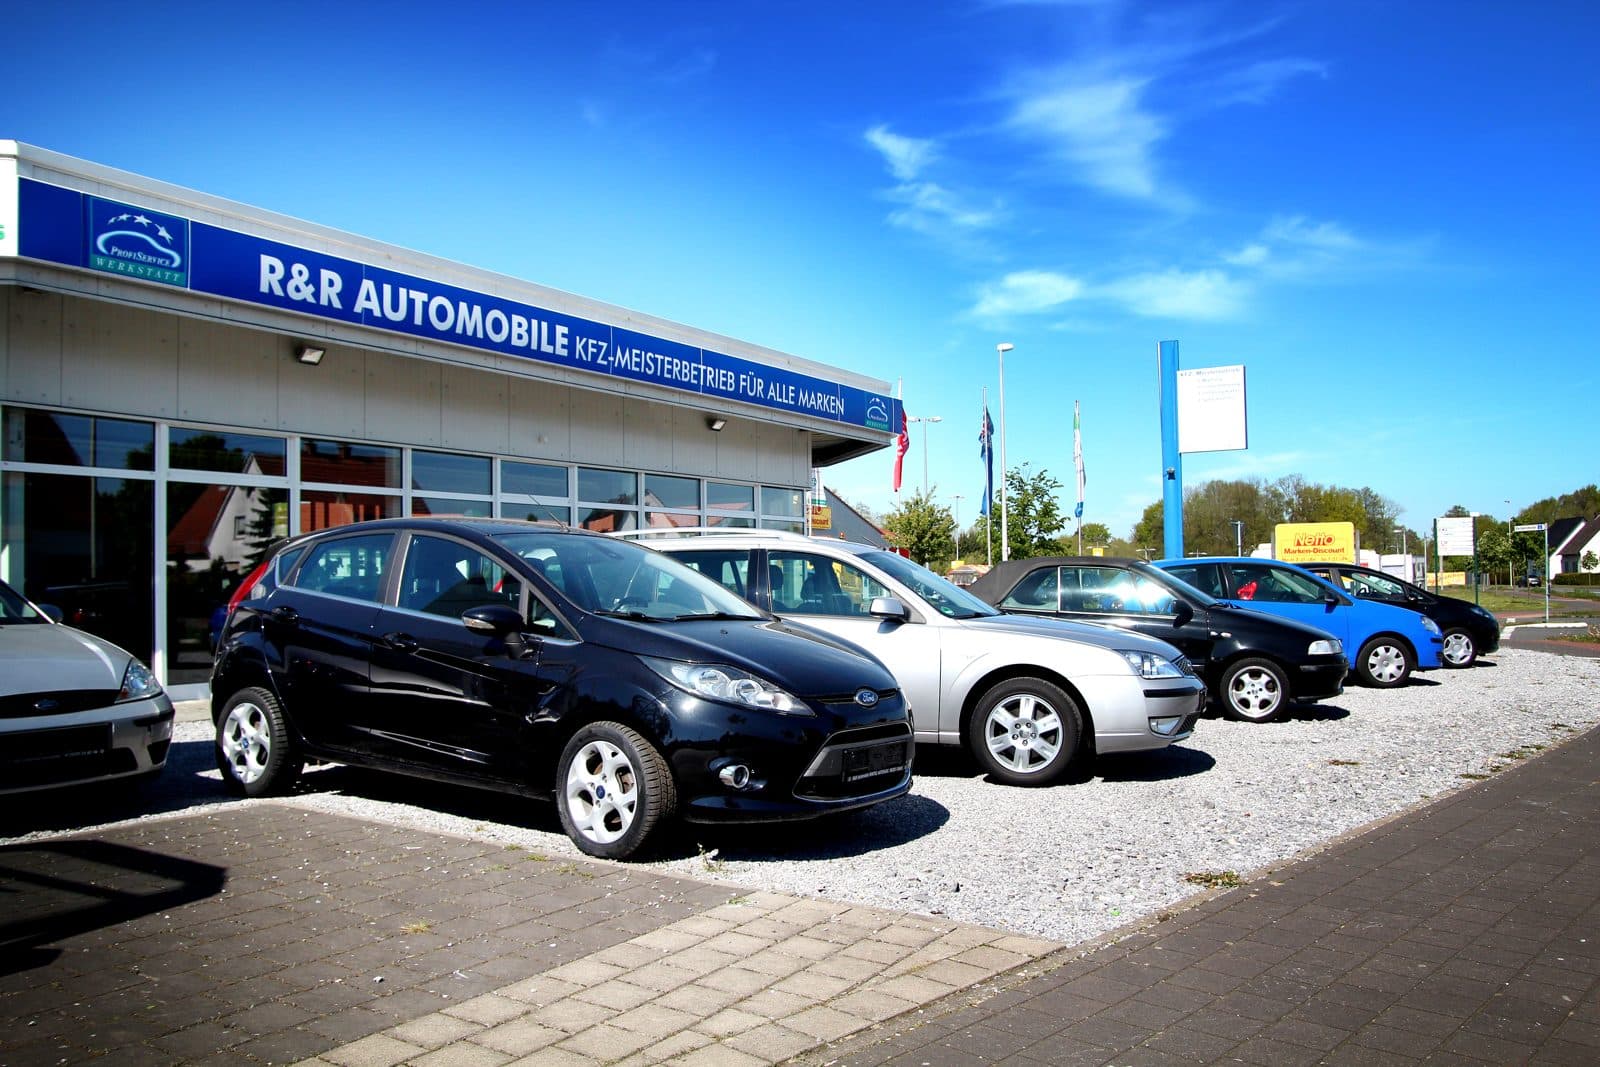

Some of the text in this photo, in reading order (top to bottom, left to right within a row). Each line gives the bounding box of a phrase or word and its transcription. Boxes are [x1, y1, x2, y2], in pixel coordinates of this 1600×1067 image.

[96, 257, 181, 282] WERKSTATT
[259, 253, 845, 416] R&R AUTOMOBILE KFZ-MEISTERBETRIEB FÜR ALLE MARKEN
[1294, 532, 1335, 547] Netto
[1284, 547, 1345, 555] Marken-Discount
[861, 692, 876, 703] Ford
